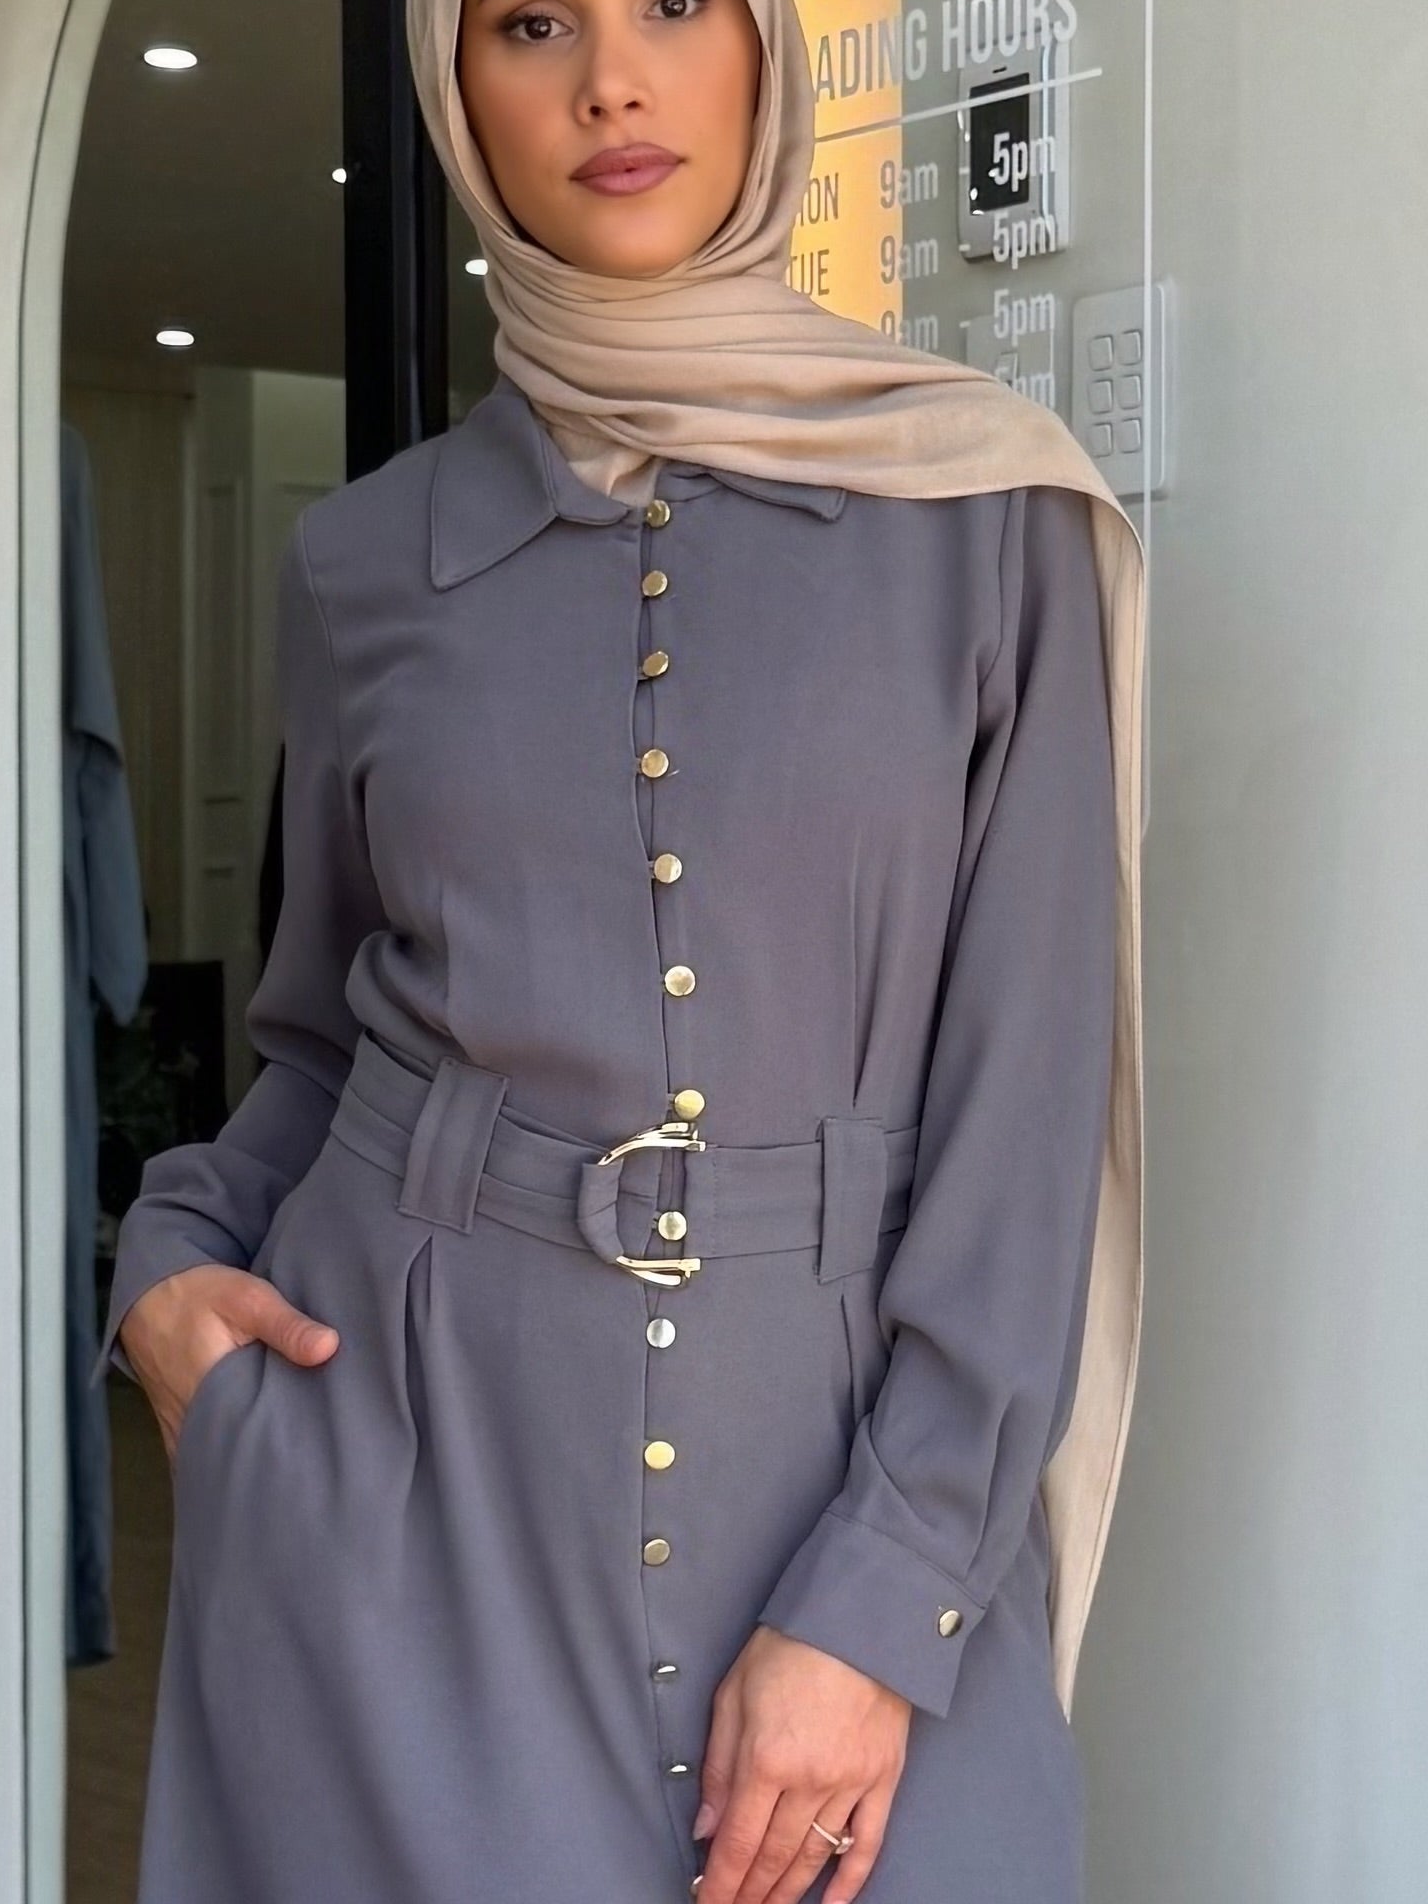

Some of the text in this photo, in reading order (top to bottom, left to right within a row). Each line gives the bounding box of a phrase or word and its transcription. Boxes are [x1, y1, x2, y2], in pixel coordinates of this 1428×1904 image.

[880, 160, 938, 209] 9am
[993, 132, 1056, 192] 5pm
[880, 235, 938, 284] 9am
[992, 212, 1057, 269] 5pm
[994, 289, 1055, 346] 5pm
